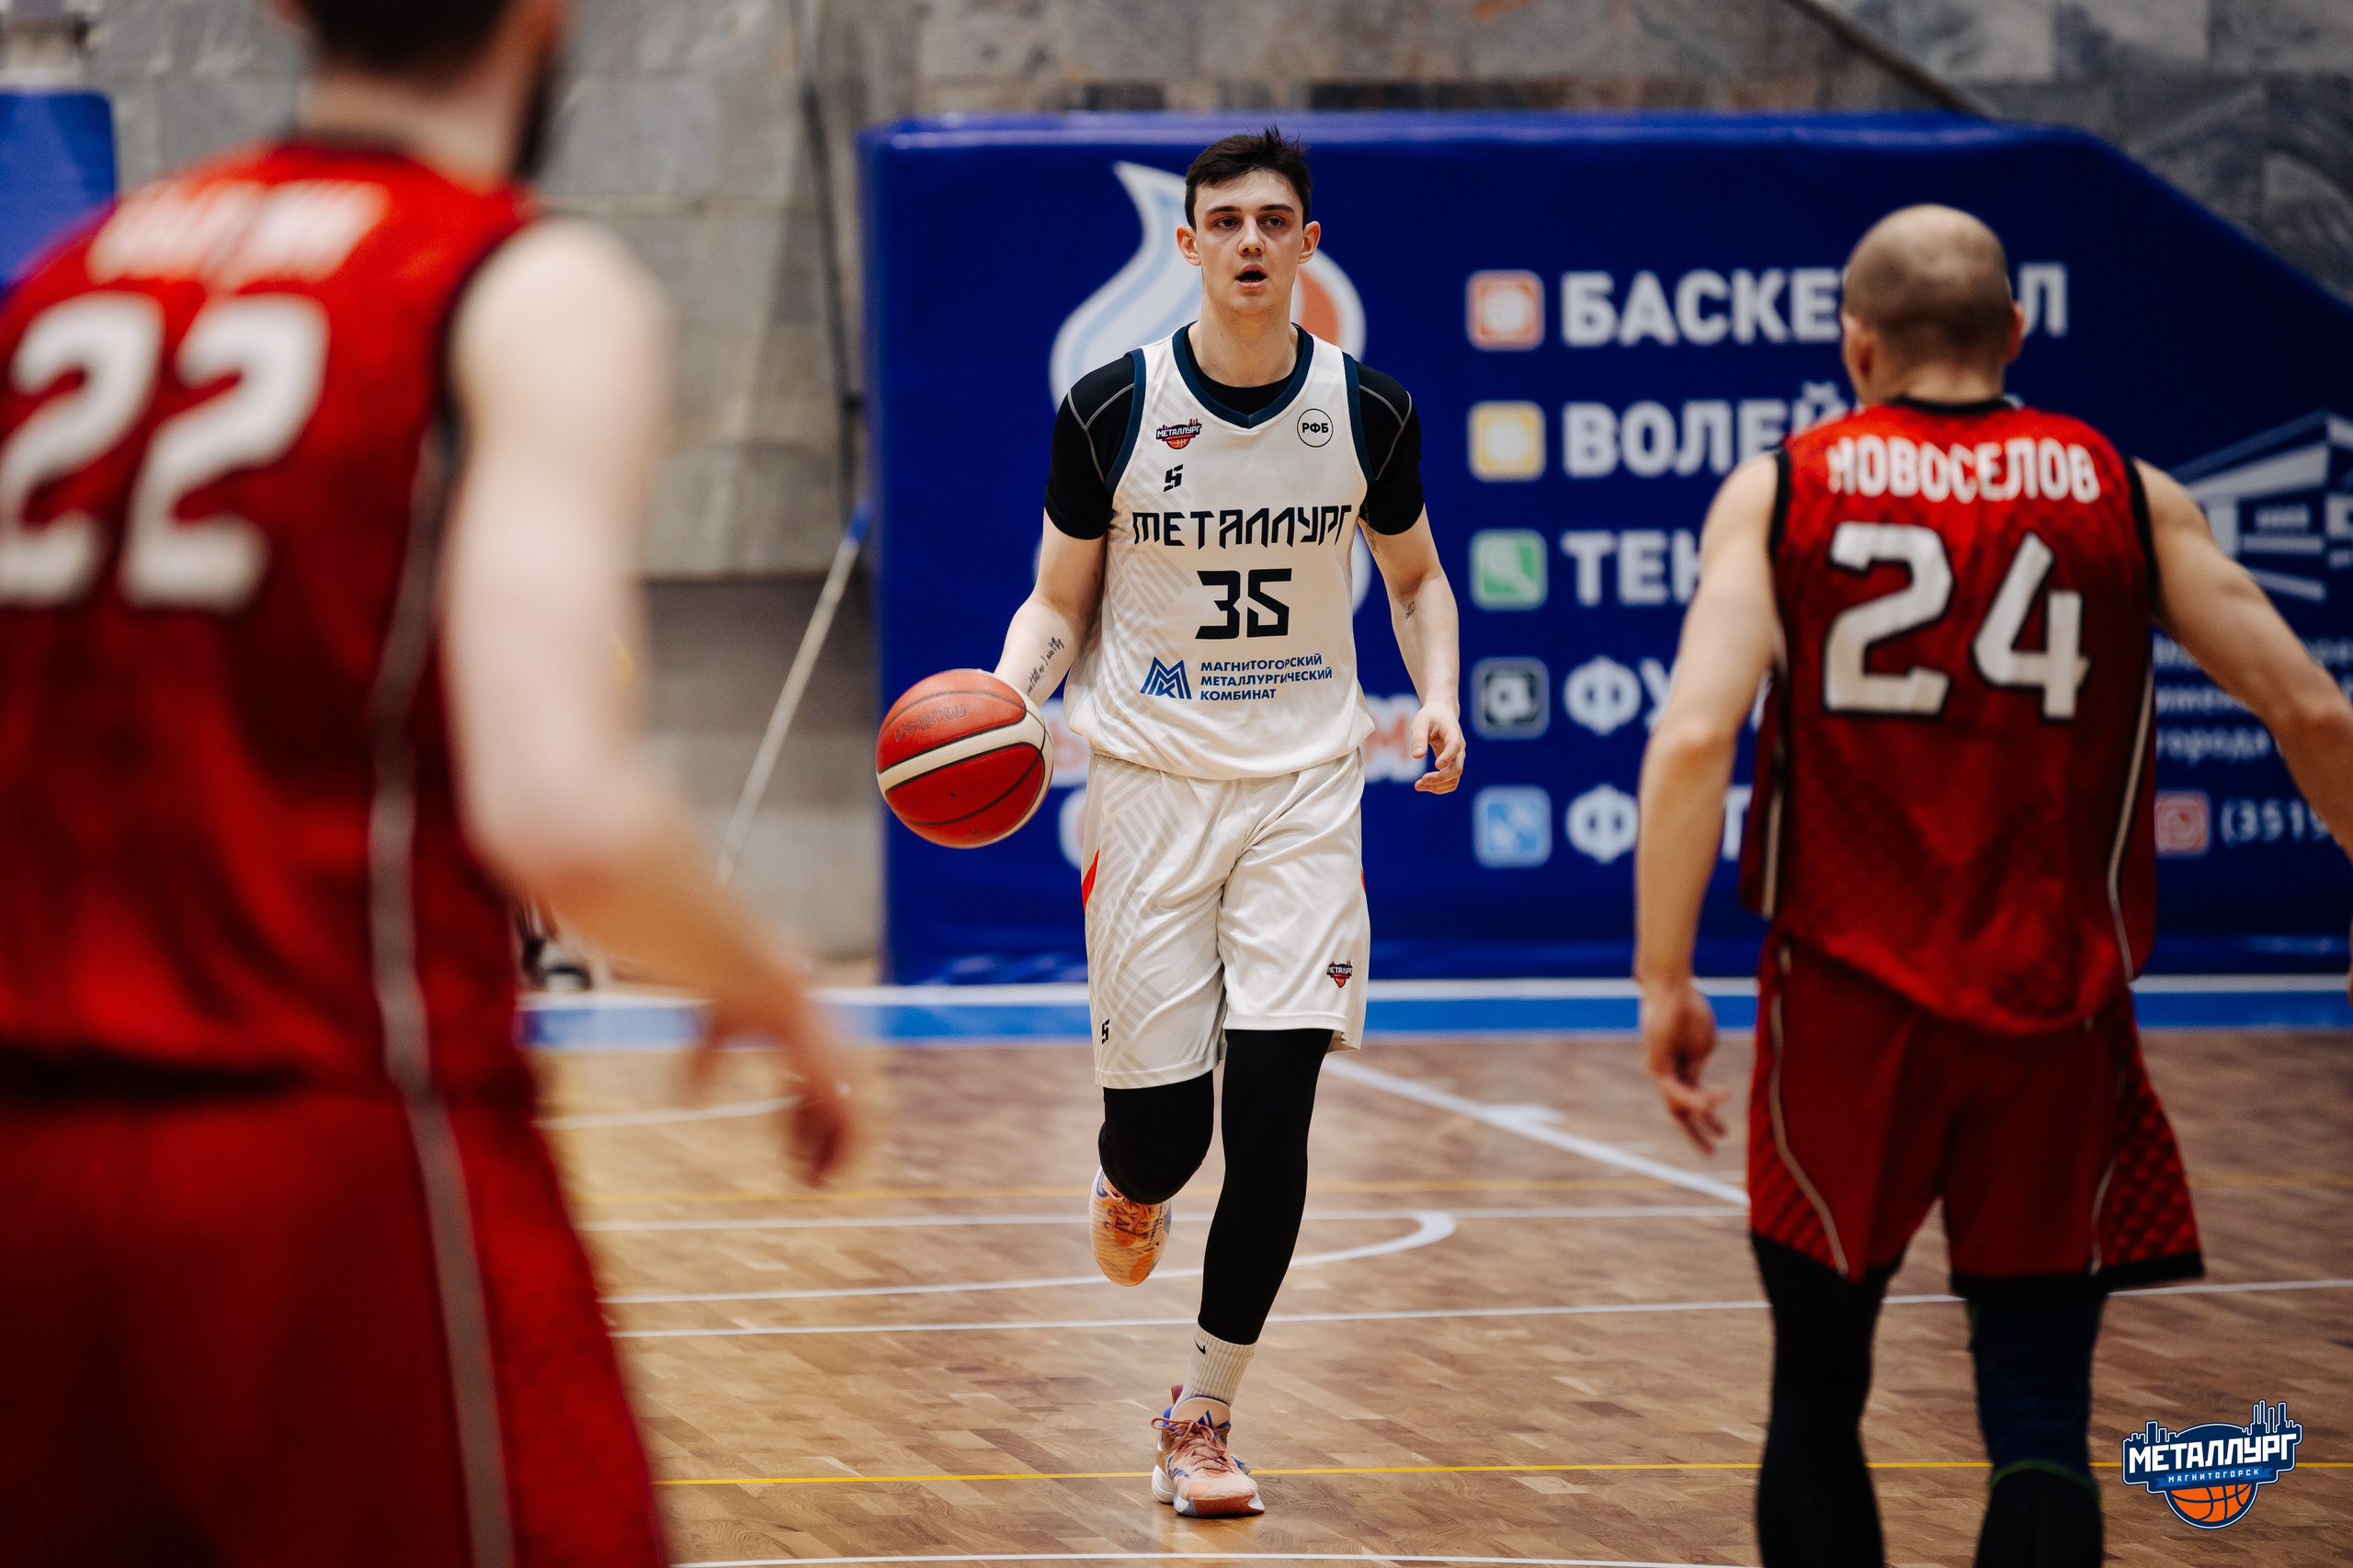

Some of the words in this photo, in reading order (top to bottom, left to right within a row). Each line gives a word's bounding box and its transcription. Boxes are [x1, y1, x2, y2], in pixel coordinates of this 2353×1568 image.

[1562, 262, 2068, 347] БАСКЕЛ
[1157, 425, 1200, 437] МЕТАЛЛУРГ
[1302, 422, 1329, 434] РФБ
[0, 290, 331, 610] 22
[1826, 433, 2101, 505] НОВОСЕЛОВ
[1131, 505, 1352, 551] МЕТАЛЛУРГ
[1195, 568, 1292, 640] 35
[1824, 520, 2092, 721] 24
[1200, 653, 1323, 672] МАГНИТОГОРСКИЙ
[1200, 666, 1333, 687] МЕТАЛЛУРГИЧЕСКИЙ
[1200, 688, 1277, 701] КОМБИНАТ
[895, 704, 967, 742] molten
